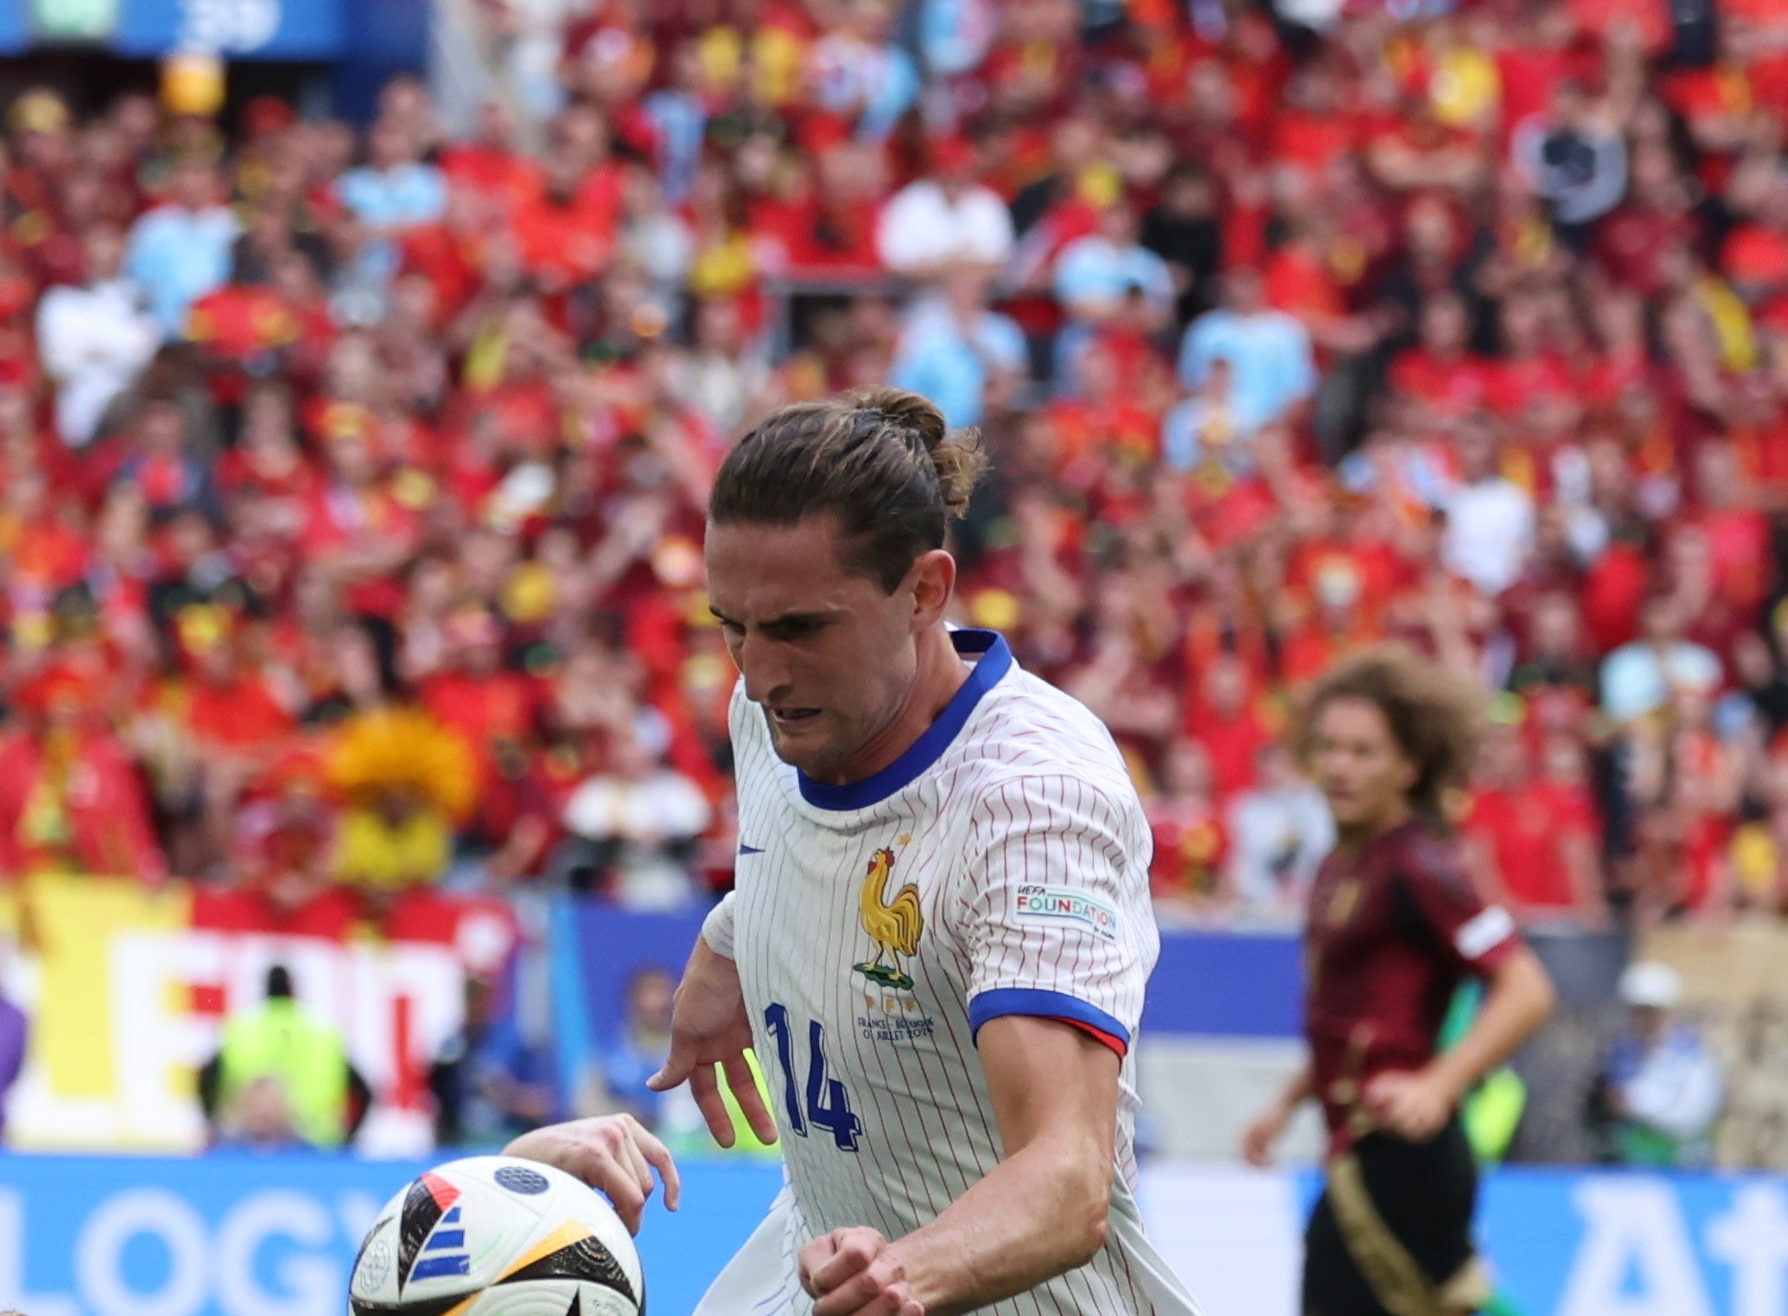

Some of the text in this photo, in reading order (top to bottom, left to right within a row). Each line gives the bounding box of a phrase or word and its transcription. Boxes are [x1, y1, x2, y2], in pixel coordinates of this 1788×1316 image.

[1017, 885, 1046, 896] UEFA
[1017, 895, 1116, 929] FOUNDATION
[764, 1002, 862, 1152] 14
